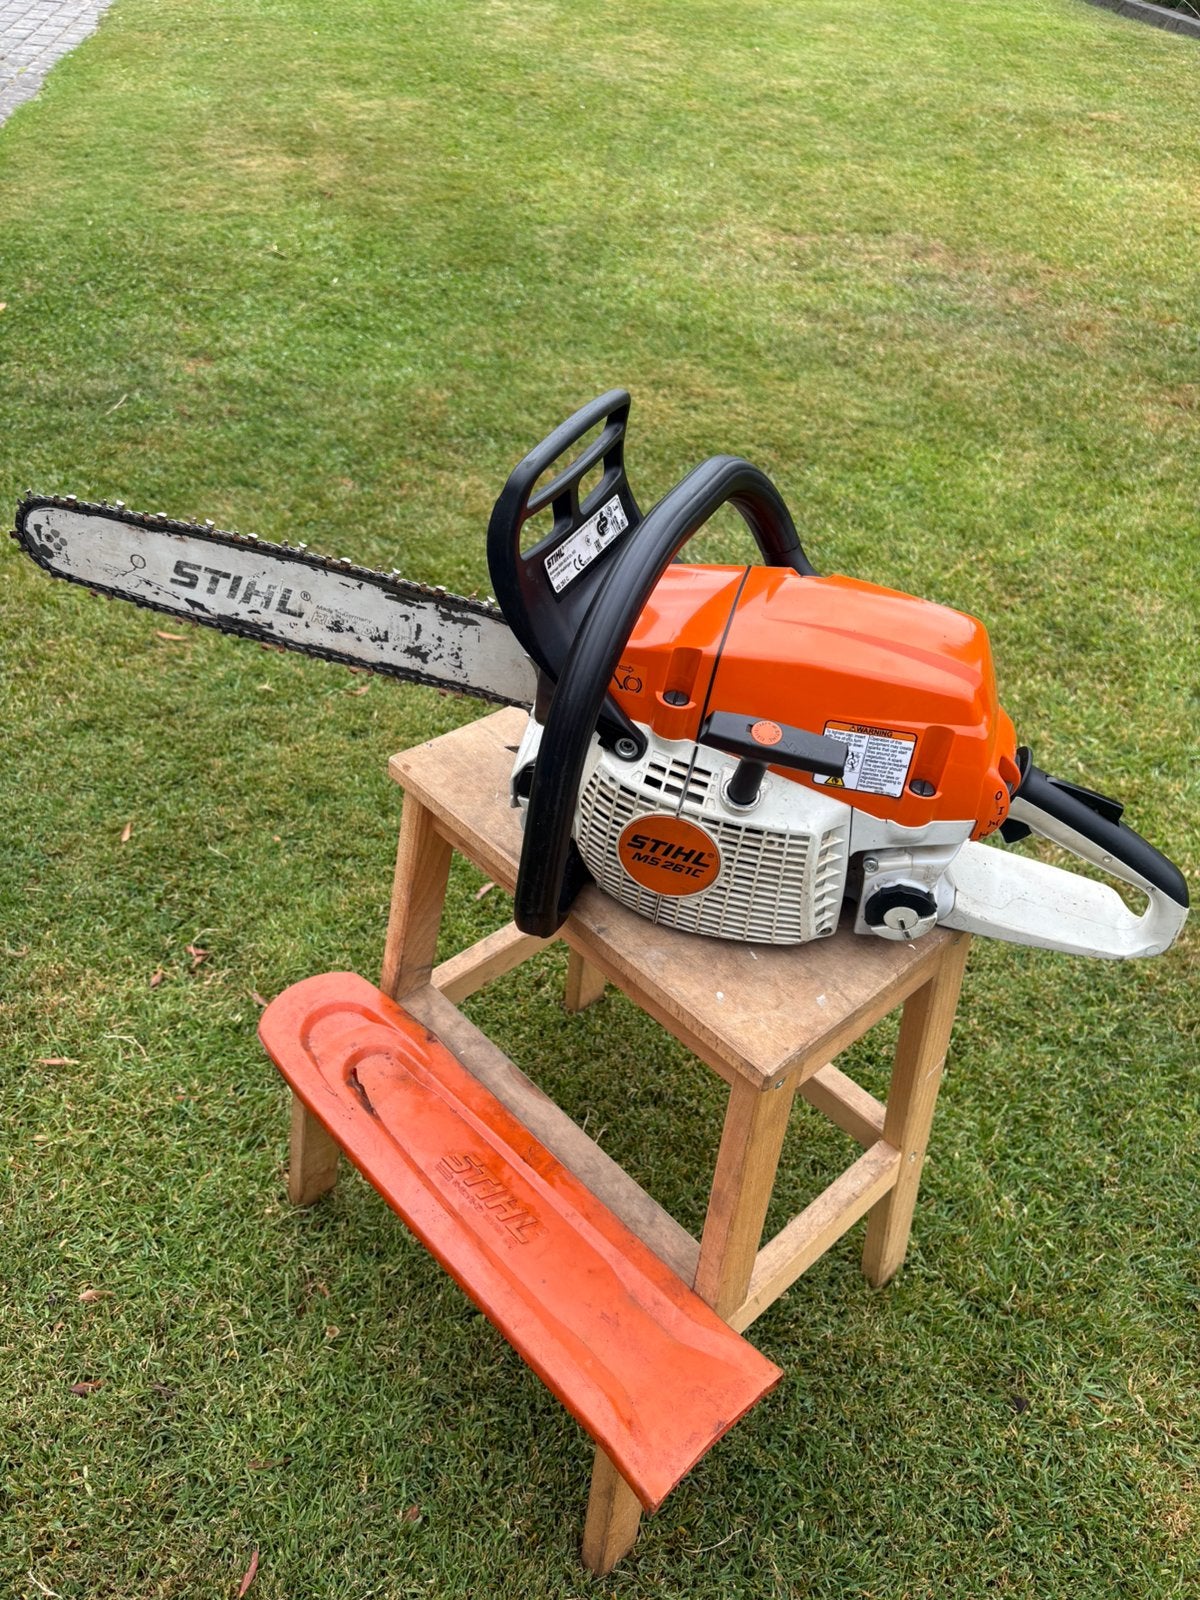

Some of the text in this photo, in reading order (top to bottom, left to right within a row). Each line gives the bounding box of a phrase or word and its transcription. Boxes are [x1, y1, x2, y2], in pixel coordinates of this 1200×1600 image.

[547, 549, 565, 569] STIHL
[169, 559, 305, 618] STIHL
[856, 726, 893, 737] WARNING
[626, 833, 710, 868] STIHL
[631, 851, 705, 878] MS 261C
[440, 1151, 539, 1245] STIHL
